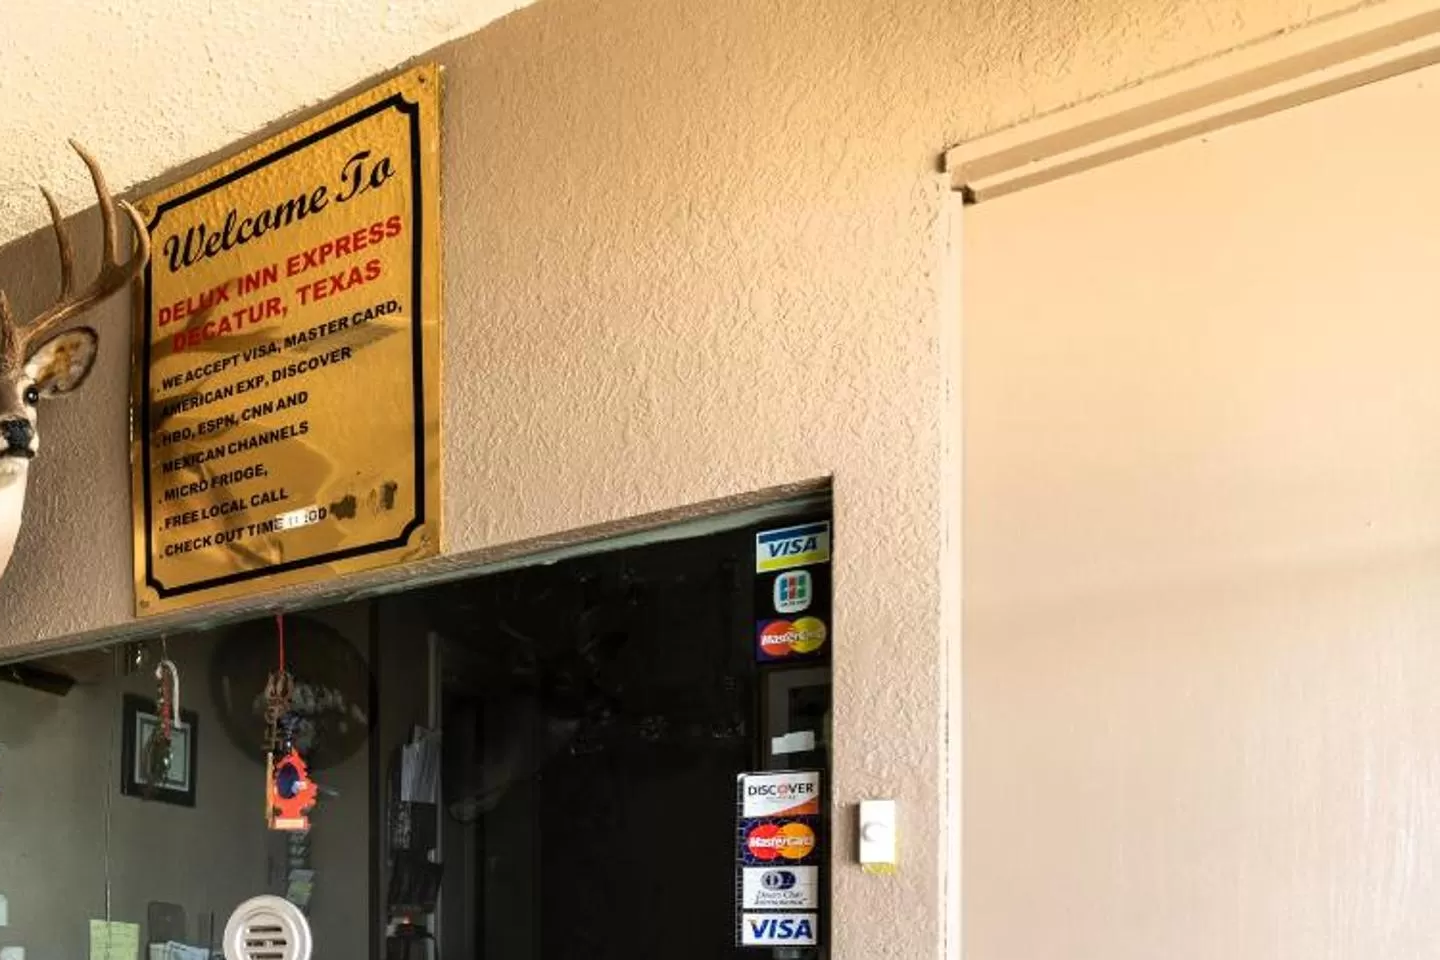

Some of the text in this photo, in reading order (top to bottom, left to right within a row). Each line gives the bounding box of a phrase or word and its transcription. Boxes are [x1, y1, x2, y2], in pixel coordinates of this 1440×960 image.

[163, 150, 396, 273] Welcome To
[158, 215, 402, 327] DELUX INN EXPRESS
[172, 259, 381, 353] DECATUR, TEXAS
[162, 300, 402, 390] WE ACCEPT VISA, MASTER CARD,
[162, 385, 233, 416] AMERICAN
[272, 346, 352, 383] DISCOVER
[198, 414, 239, 436] ESPN,
[241, 401, 273, 420] CNN
[276, 391, 308, 411] AND
[162, 421, 309, 473] MEXICAN CHANNELS
[164, 464, 268, 501] MICRO FRIDGE,
[165, 488, 289, 530] FREE LOCAL CALL
[165, 536, 212, 557] CHECK
[214, 528, 244, 544] OUT
[248, 518, 283, 537] TIME
[768, 536, 817, 557] VISA
[748, 783, 813, 796] DISCOVER
[749, 919, 813, 939] VISA
